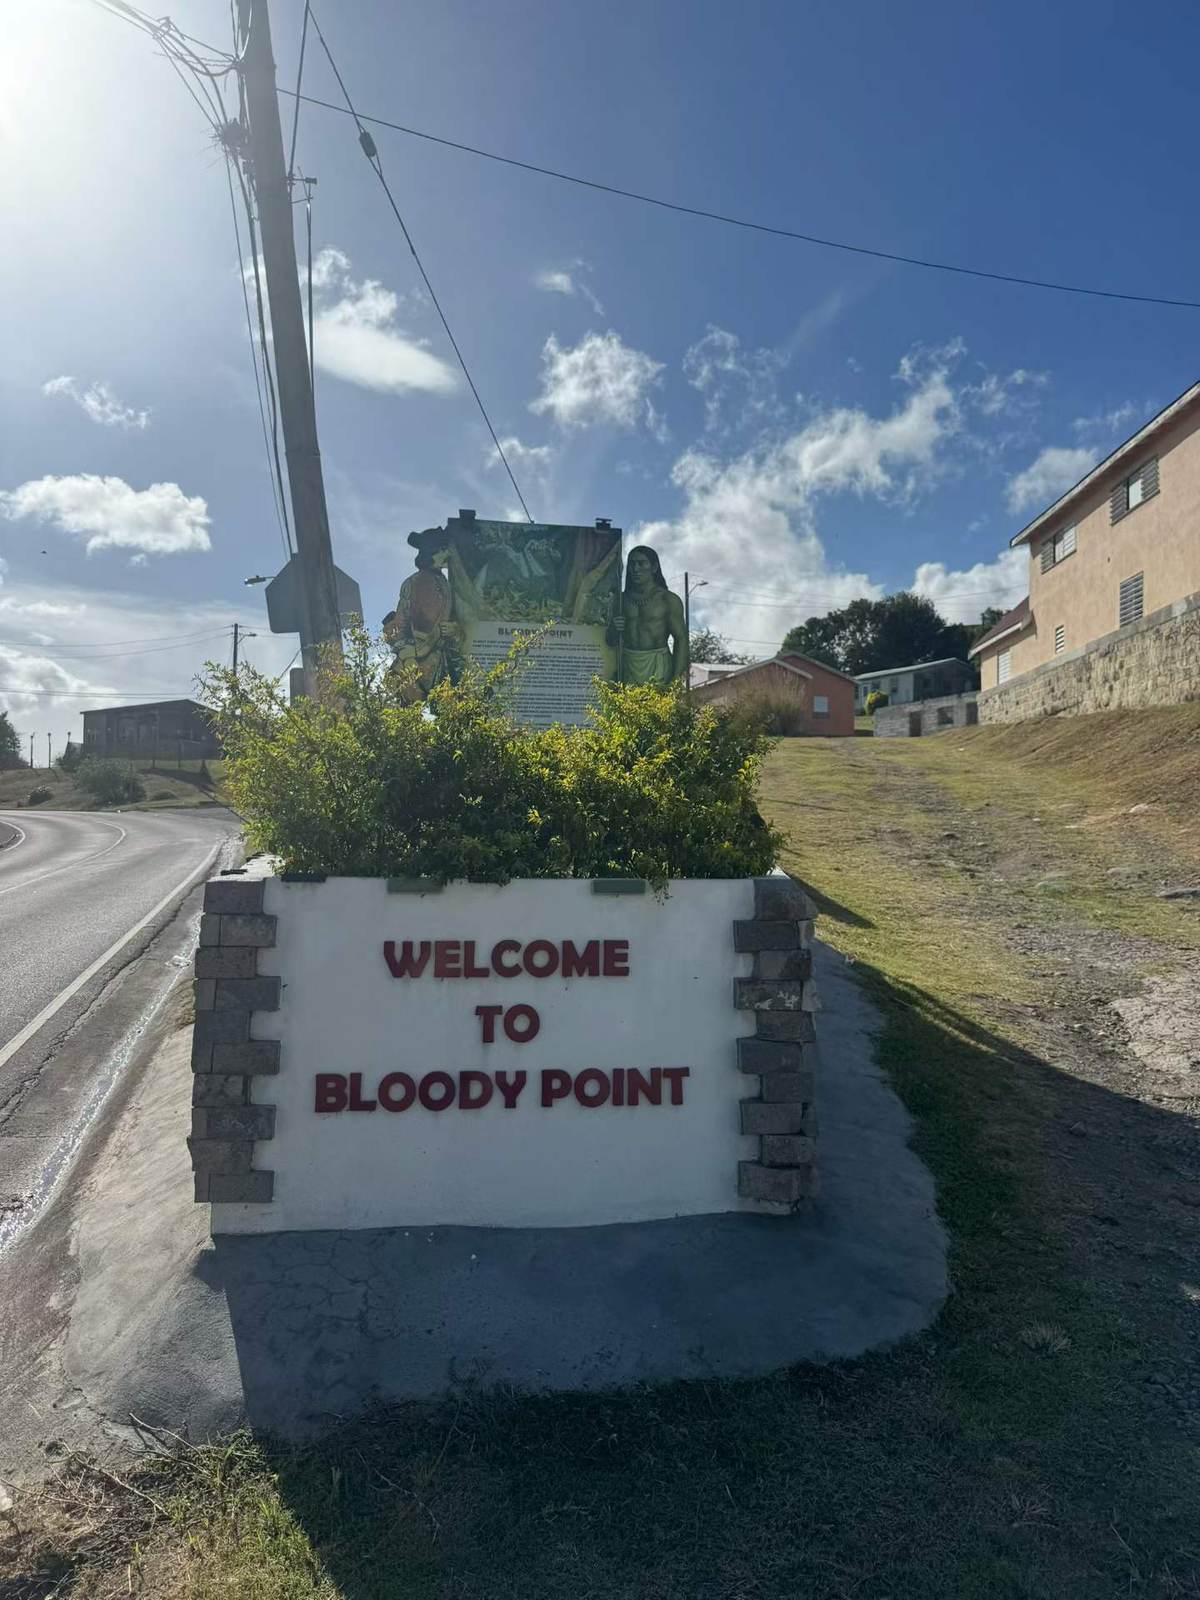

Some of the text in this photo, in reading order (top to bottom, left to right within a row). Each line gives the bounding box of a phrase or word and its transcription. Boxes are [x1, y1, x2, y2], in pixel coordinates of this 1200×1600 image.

[383, 940, 629, 978] WELCOME
[475, 1004, 540, 1043] TO
[315, 1067, 690, 1112] BLOODY POINT
